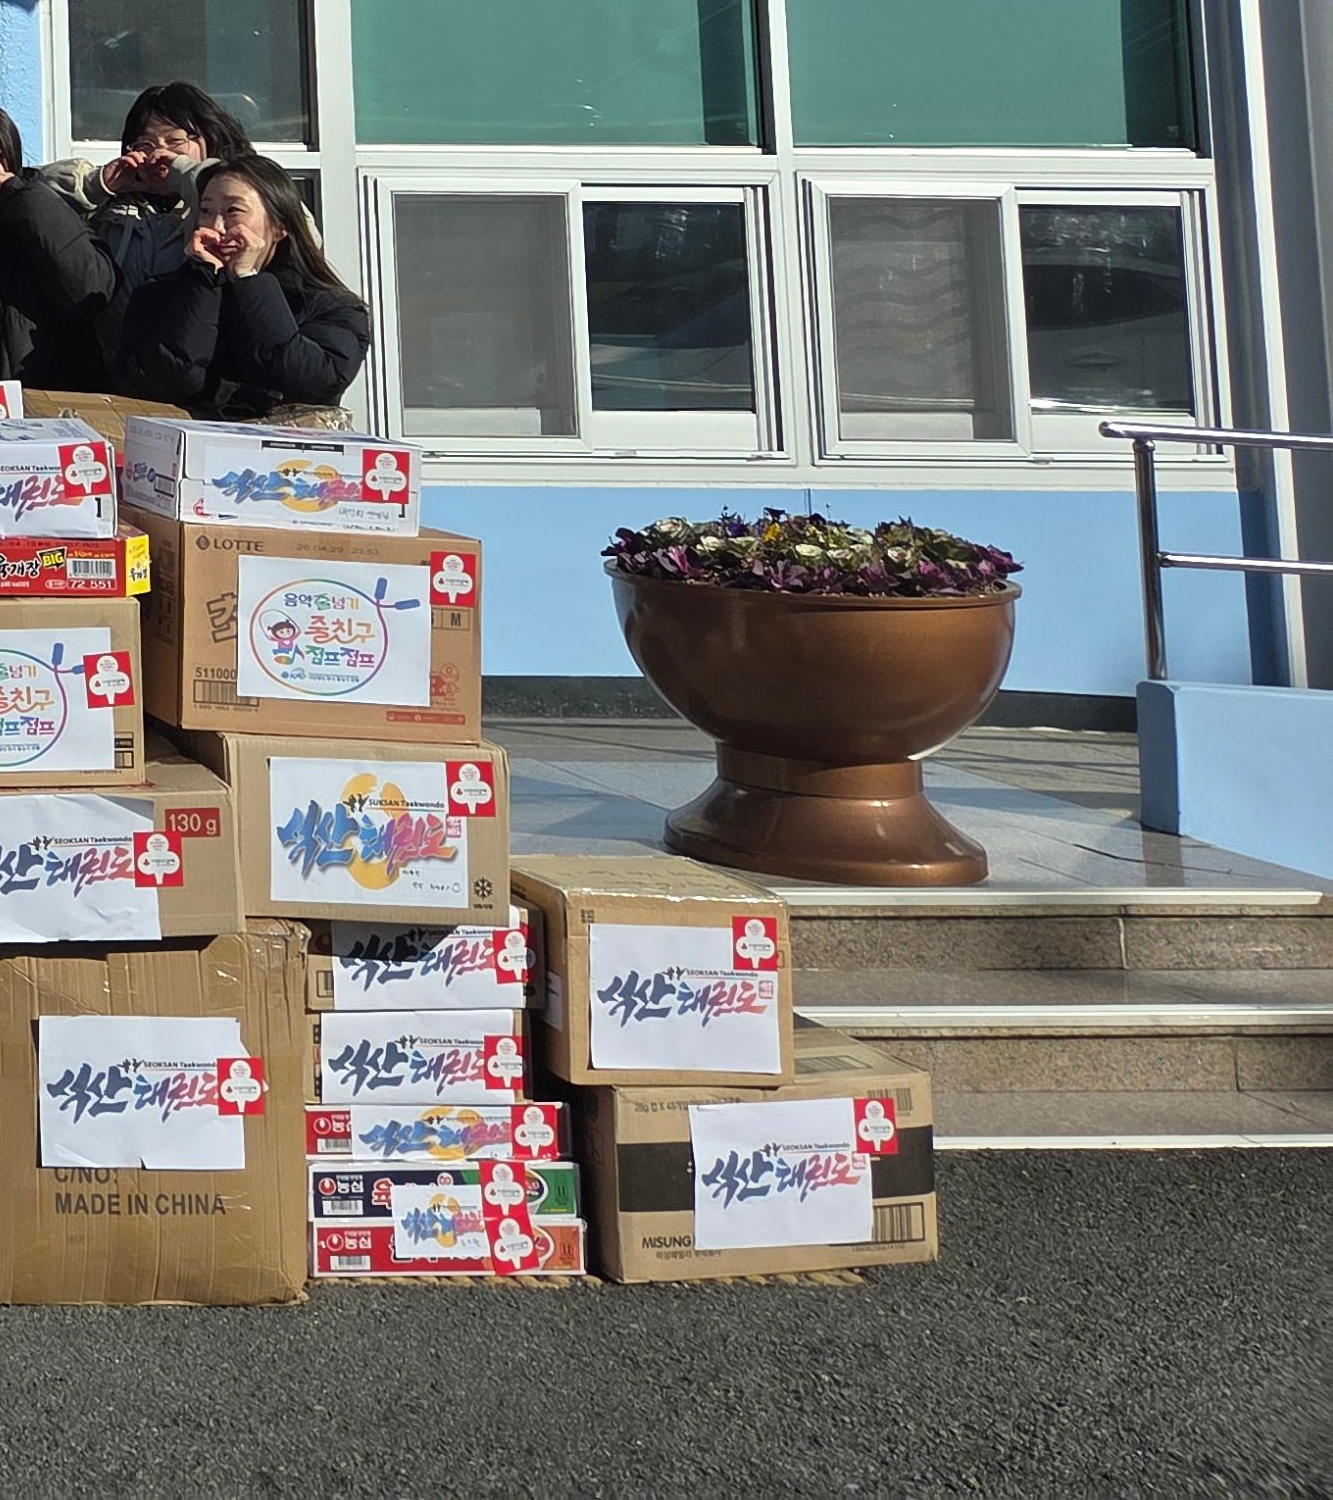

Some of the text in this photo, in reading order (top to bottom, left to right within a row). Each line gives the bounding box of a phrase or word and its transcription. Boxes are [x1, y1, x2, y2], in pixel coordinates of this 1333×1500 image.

[213, 538, 265, 552] LOTTE
[42, 553, 65, 567] BIG
[70, 581, 112, 589] 72 551
[450, 612, 461, 627] M
[168, 814, 218, 838] 130 g
[336, 1179, 364, 1194] 농심
[54, 1192, 227, 1216] MADE IN CHINA
[642, 1236, 692, 1249] MISUNG
